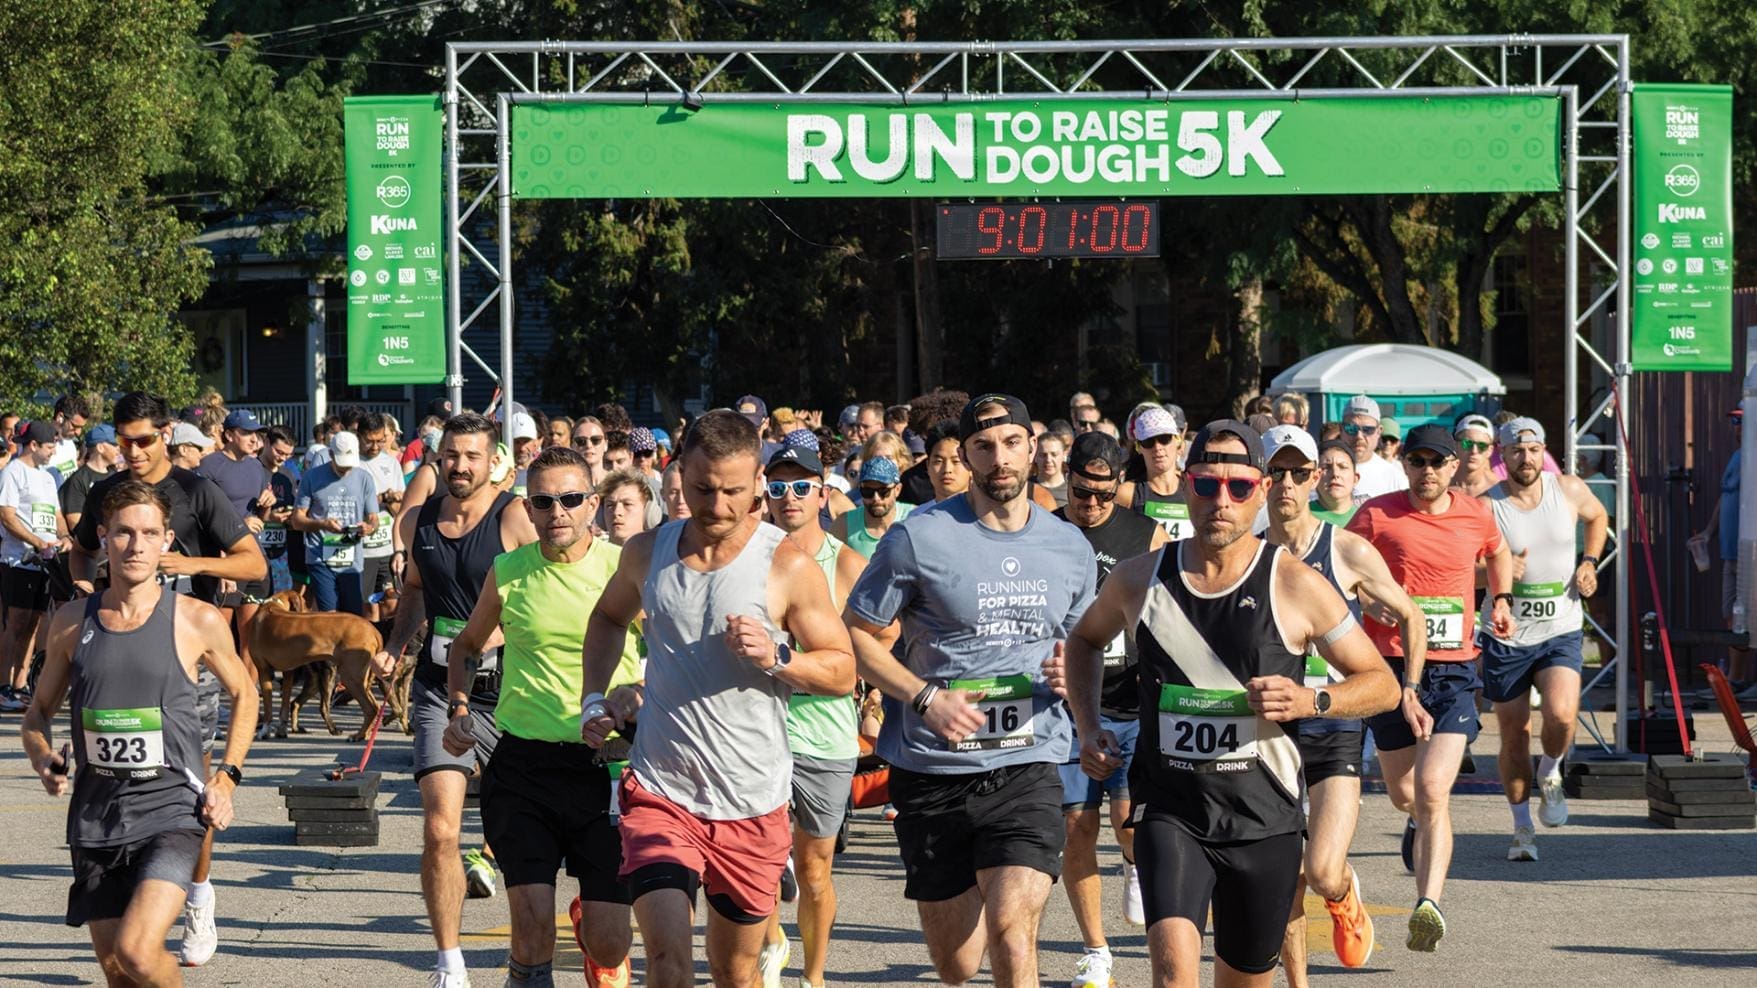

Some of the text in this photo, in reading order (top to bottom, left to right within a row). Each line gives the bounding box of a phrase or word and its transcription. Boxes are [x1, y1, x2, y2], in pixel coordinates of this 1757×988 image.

[985, 109, 1168, 143] TO RAISE
[1666, 112, 1699, 124] RUN
[376, 122, 409, 135] RUN
[376, 142, 409, 150] DOUGH
[787, 113, 976, 183] RUN
[1175, 109, 1284, 178] 5K
[985, 144, 1170, 184] DOUGH
[1665, 174, 1697, 186] R365
[376, 186, 408, 198] R365
[1658, 203, 1706, 223] KUNA
[370, 215, 418, 235] KUNA
[1668, 326, 1695, 339] 1N5
[383, 337, 409, 350] 1N5
[265, 531, 284, 542] 230
[977, 579, 1048, 595] RUNNING
[978, 594, 1047, 610] FOR PIZZA
[1521, 601, 1556, 617] 290
[977, 608, 1045, 624] & MENTAL
[976, 620, 1044, 637] HEALTH
[1179, 697, 1199, 707] RUN
[957, 738, 1026, 750] PIZZA DRINK
[1174, 720, 1240, 754] 204
[96, 737, 147, 763] 323
[1169, 759, 1249, 771] PIZZA DRINK
[130, 769, 158, 778] DRINK
